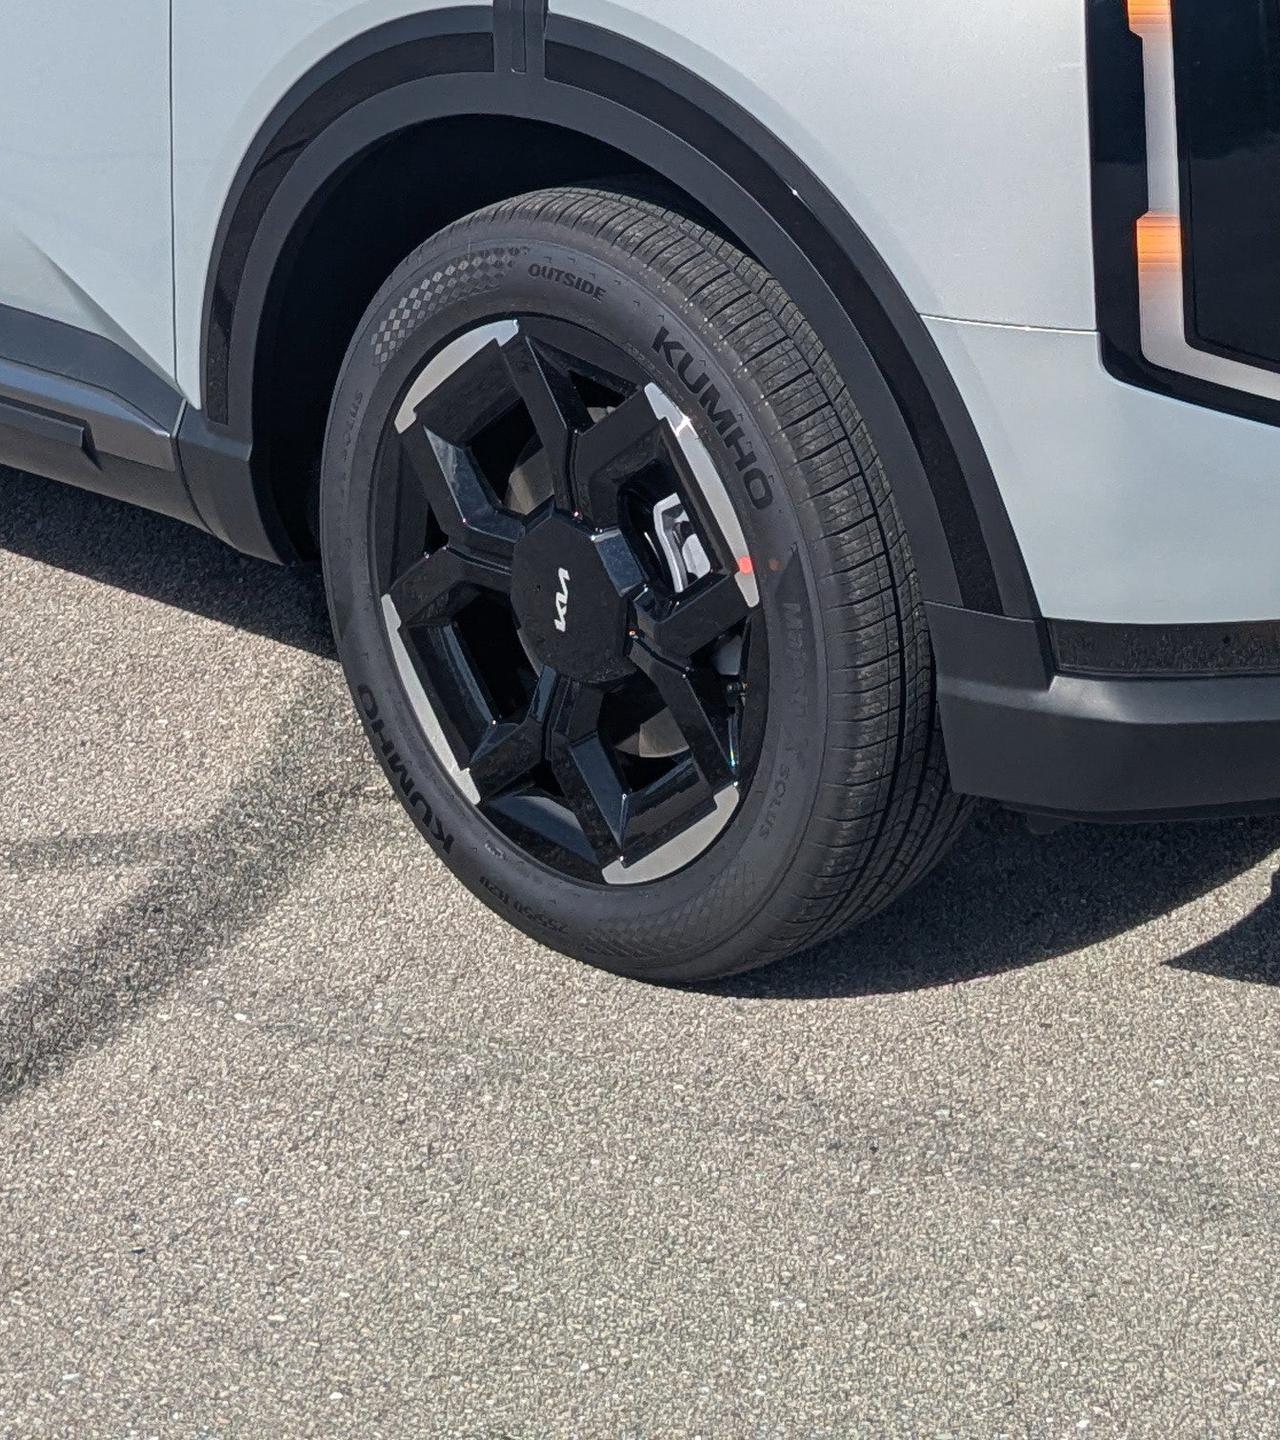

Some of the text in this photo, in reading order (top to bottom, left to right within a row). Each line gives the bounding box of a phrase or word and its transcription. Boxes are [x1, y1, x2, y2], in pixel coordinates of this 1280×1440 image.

[527, 262, 608, 302] OUTSIDE
[651, 326, 773, 509] KUMHO
[554, 567, 571, 632] KIA
[357, 684, 455, 855] KUMHO
